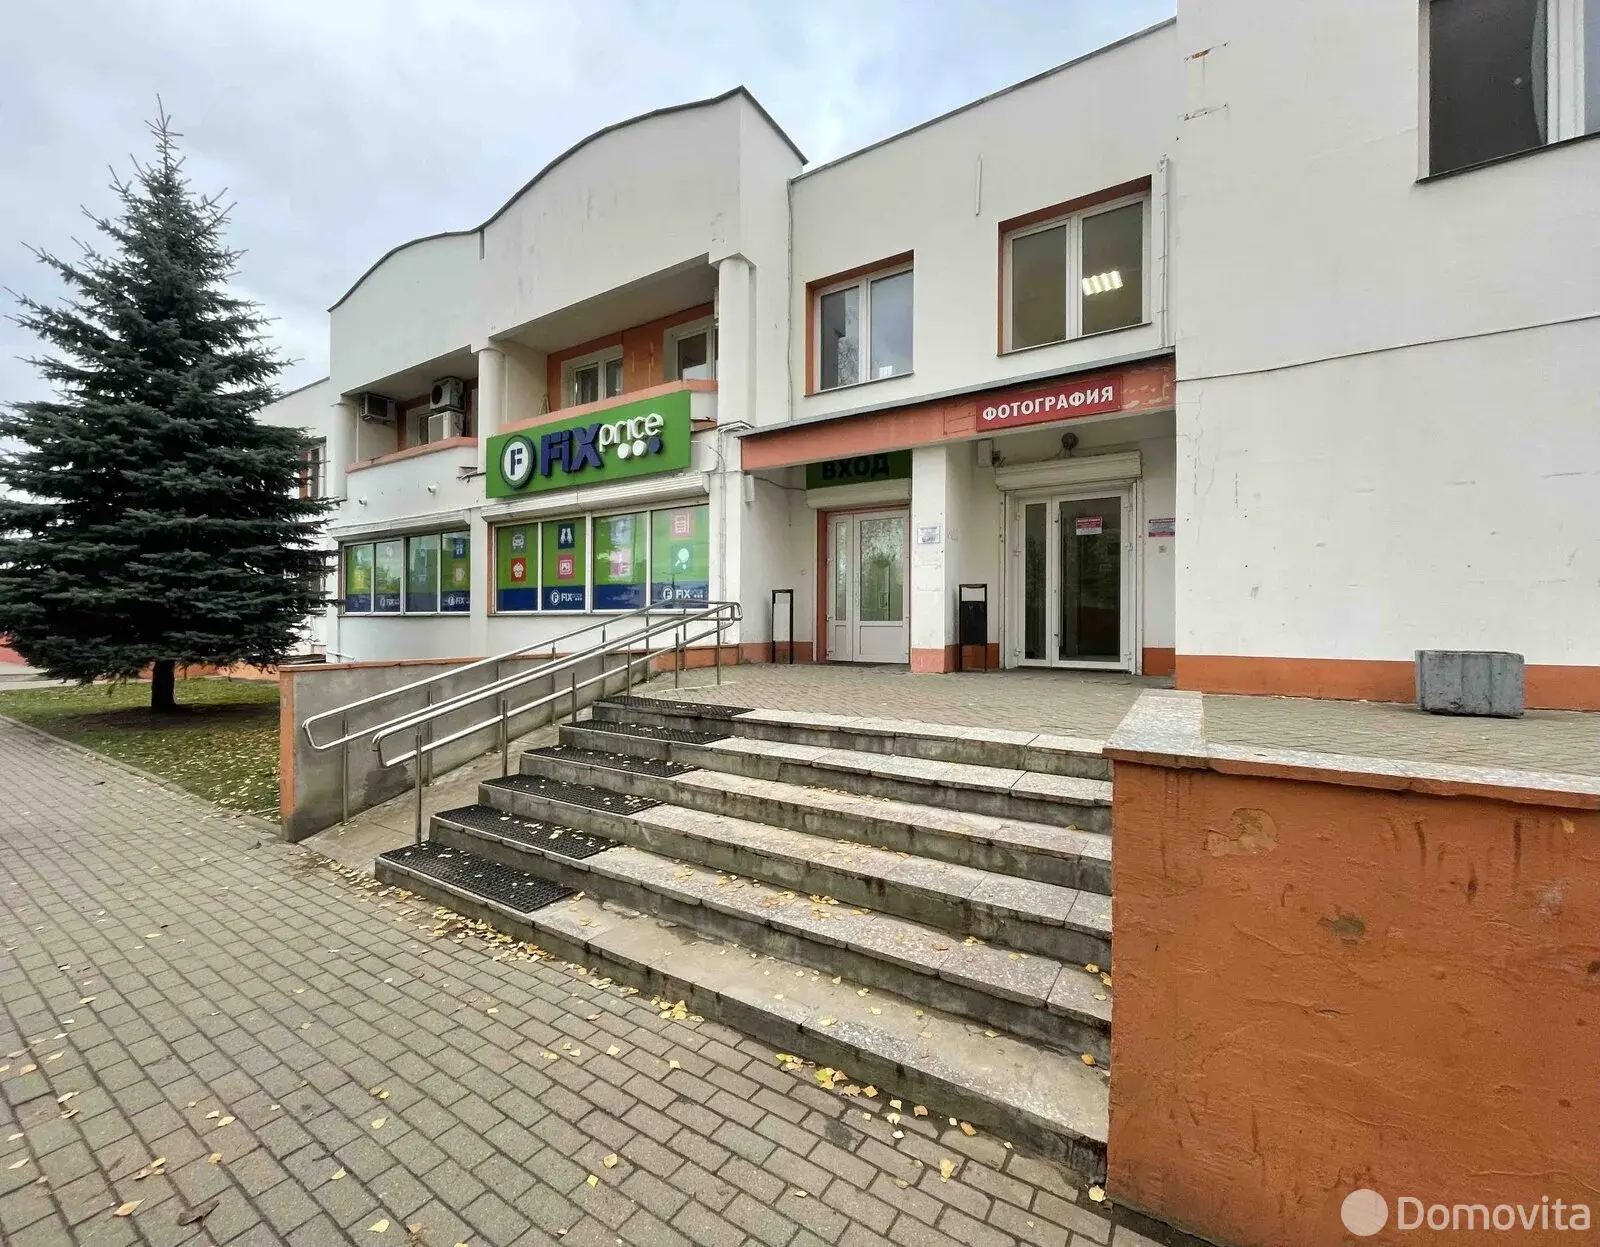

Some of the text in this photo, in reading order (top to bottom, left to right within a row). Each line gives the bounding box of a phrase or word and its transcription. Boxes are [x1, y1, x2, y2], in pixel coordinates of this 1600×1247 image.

[982, 385, 1114, 421] ФОТОГРАФИЯ
[599, 412, 664, 452] price
[823, 454, 889, 479] ВХОД
